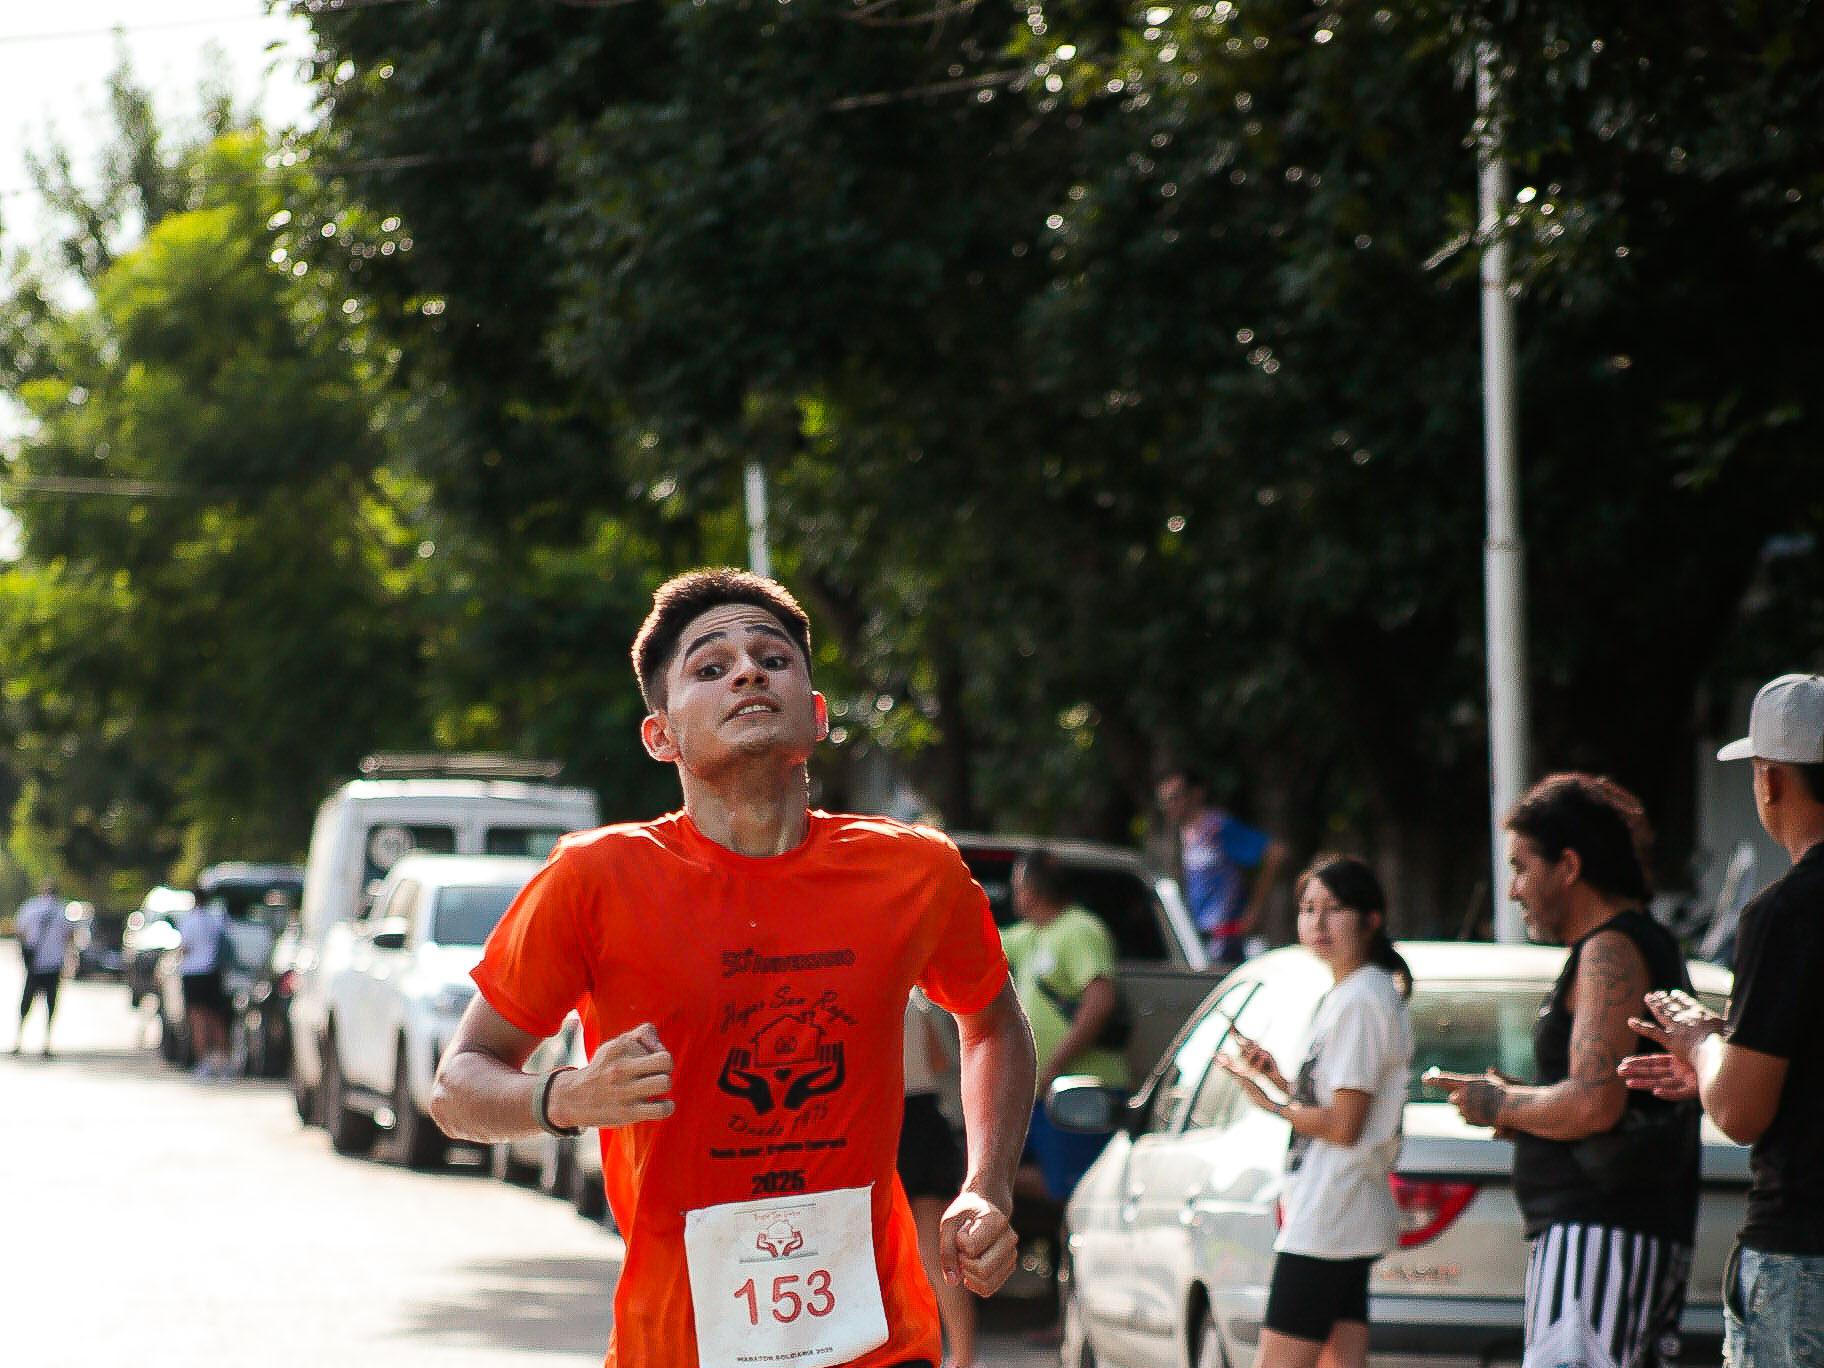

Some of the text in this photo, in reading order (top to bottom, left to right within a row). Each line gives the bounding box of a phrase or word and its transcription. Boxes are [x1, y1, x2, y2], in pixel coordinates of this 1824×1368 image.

[770, 985, 807, 1009] San
[752, 1169, 806, 1194] 2025
[733, 1269, 836, 1326] 153
